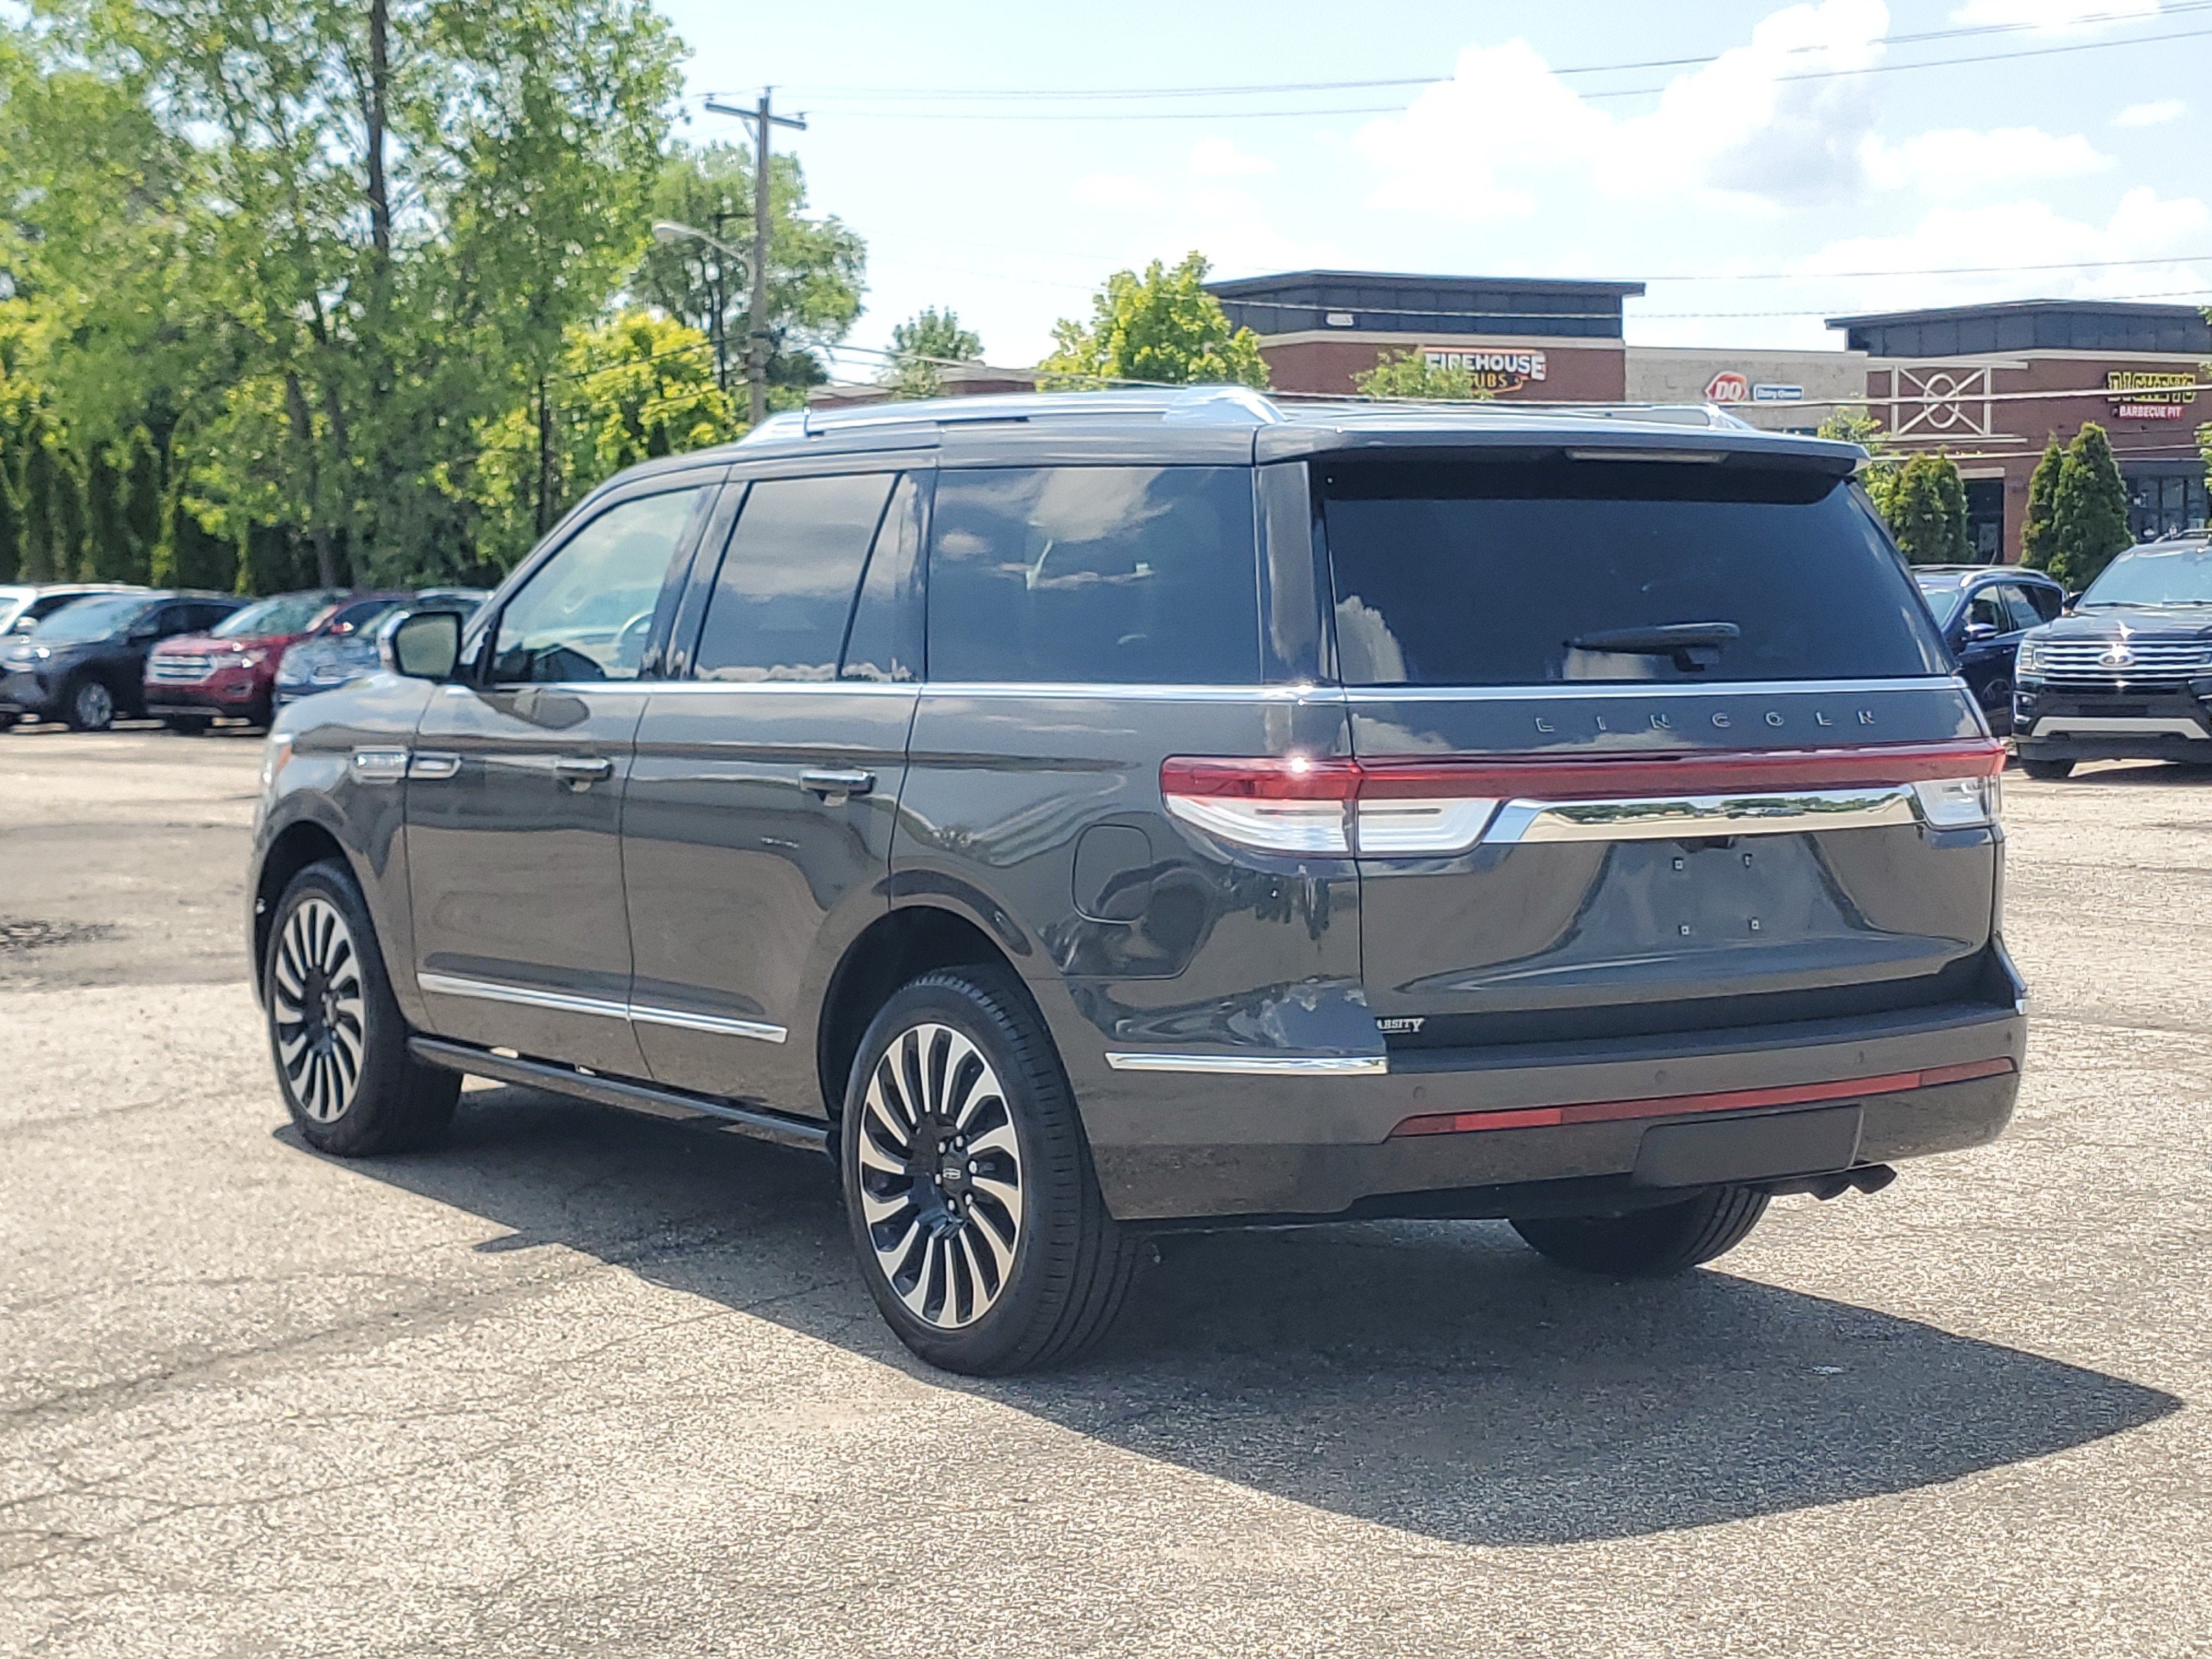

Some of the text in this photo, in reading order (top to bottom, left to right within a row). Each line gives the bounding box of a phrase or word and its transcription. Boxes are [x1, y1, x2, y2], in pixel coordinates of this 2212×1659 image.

[1425, 352, 1546, 381] FIREHOUSE
[2120, 405, 2181, 418] BARBECUE PIT
[1536, 710, 1875, 733] LINCOLN
[1376, 1018, 1425, 1032] ARSITY
